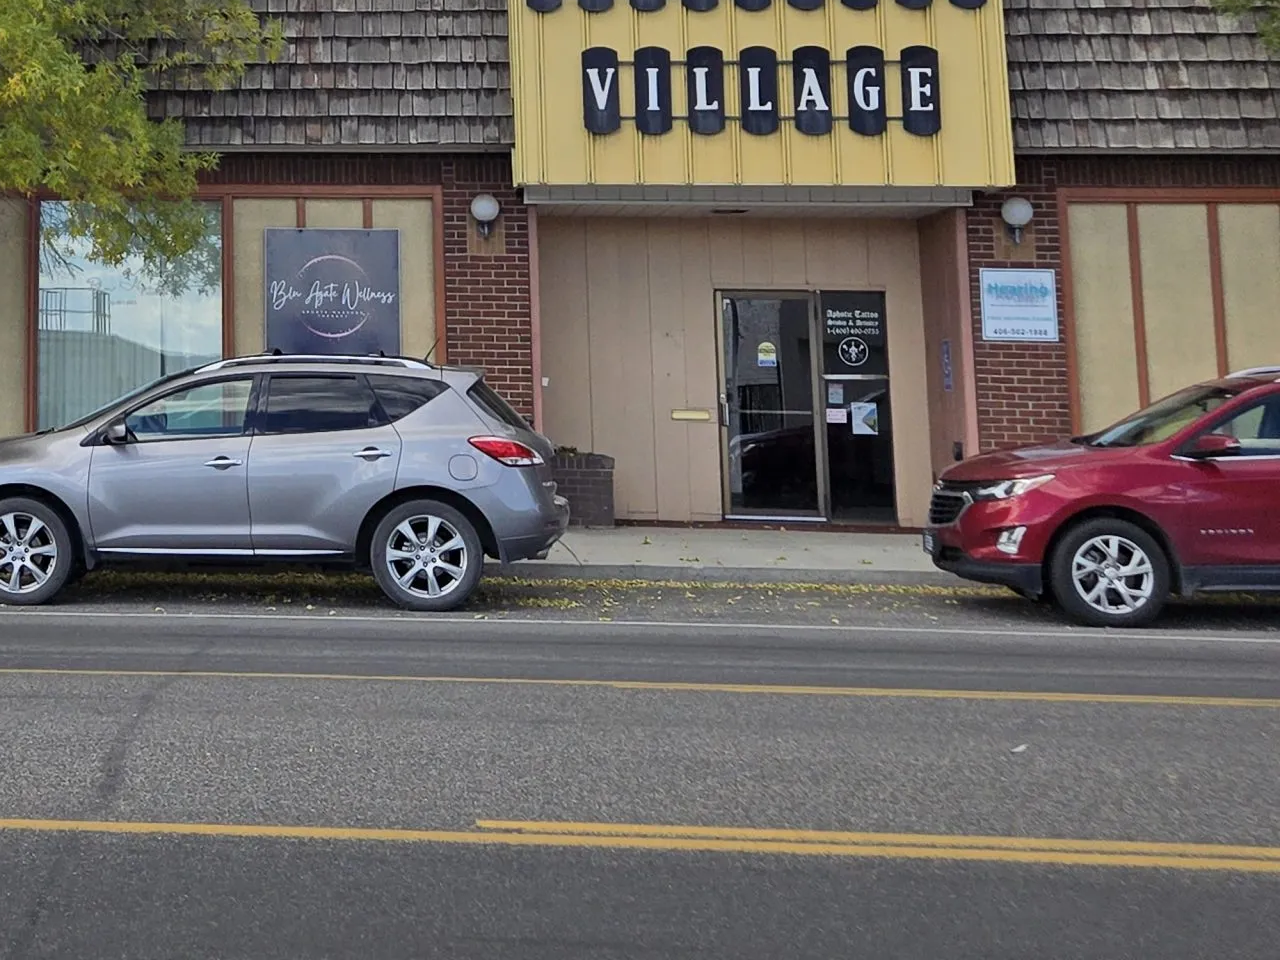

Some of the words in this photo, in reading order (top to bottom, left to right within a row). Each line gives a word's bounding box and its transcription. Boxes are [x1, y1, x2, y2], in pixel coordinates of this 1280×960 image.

[586, 66, 935, 112] VILLAGE
[305, 280, 339, 309] Agate
[342, 280, 396, 310] Wellness
[987, 282, 1049, 297] Hearing
[854, 310, 879, 318] Tattoo
